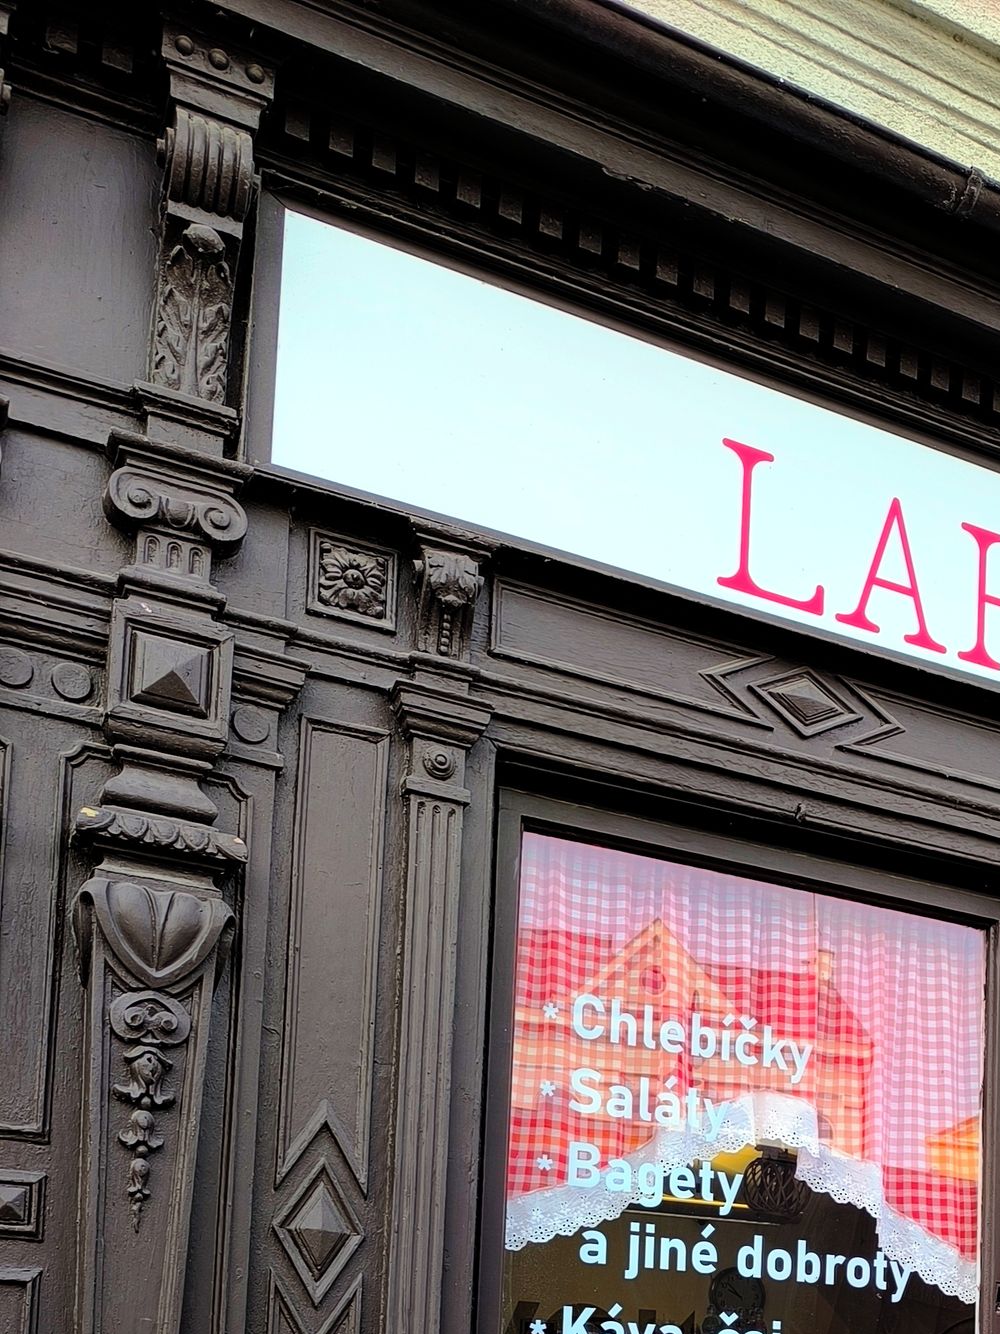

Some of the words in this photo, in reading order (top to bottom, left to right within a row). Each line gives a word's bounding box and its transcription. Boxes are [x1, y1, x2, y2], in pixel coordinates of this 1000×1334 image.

[571, 994, 814, 1083] Chlebíčky
[568, 1068, 730, 1141] Saláty
[566, 1142, 743, 1216] Bagety
[579, 1230, 607, 1265] a
[624, 1222, 718, 1280] jiné
[736, 1234, 914, 1303] dobroty
